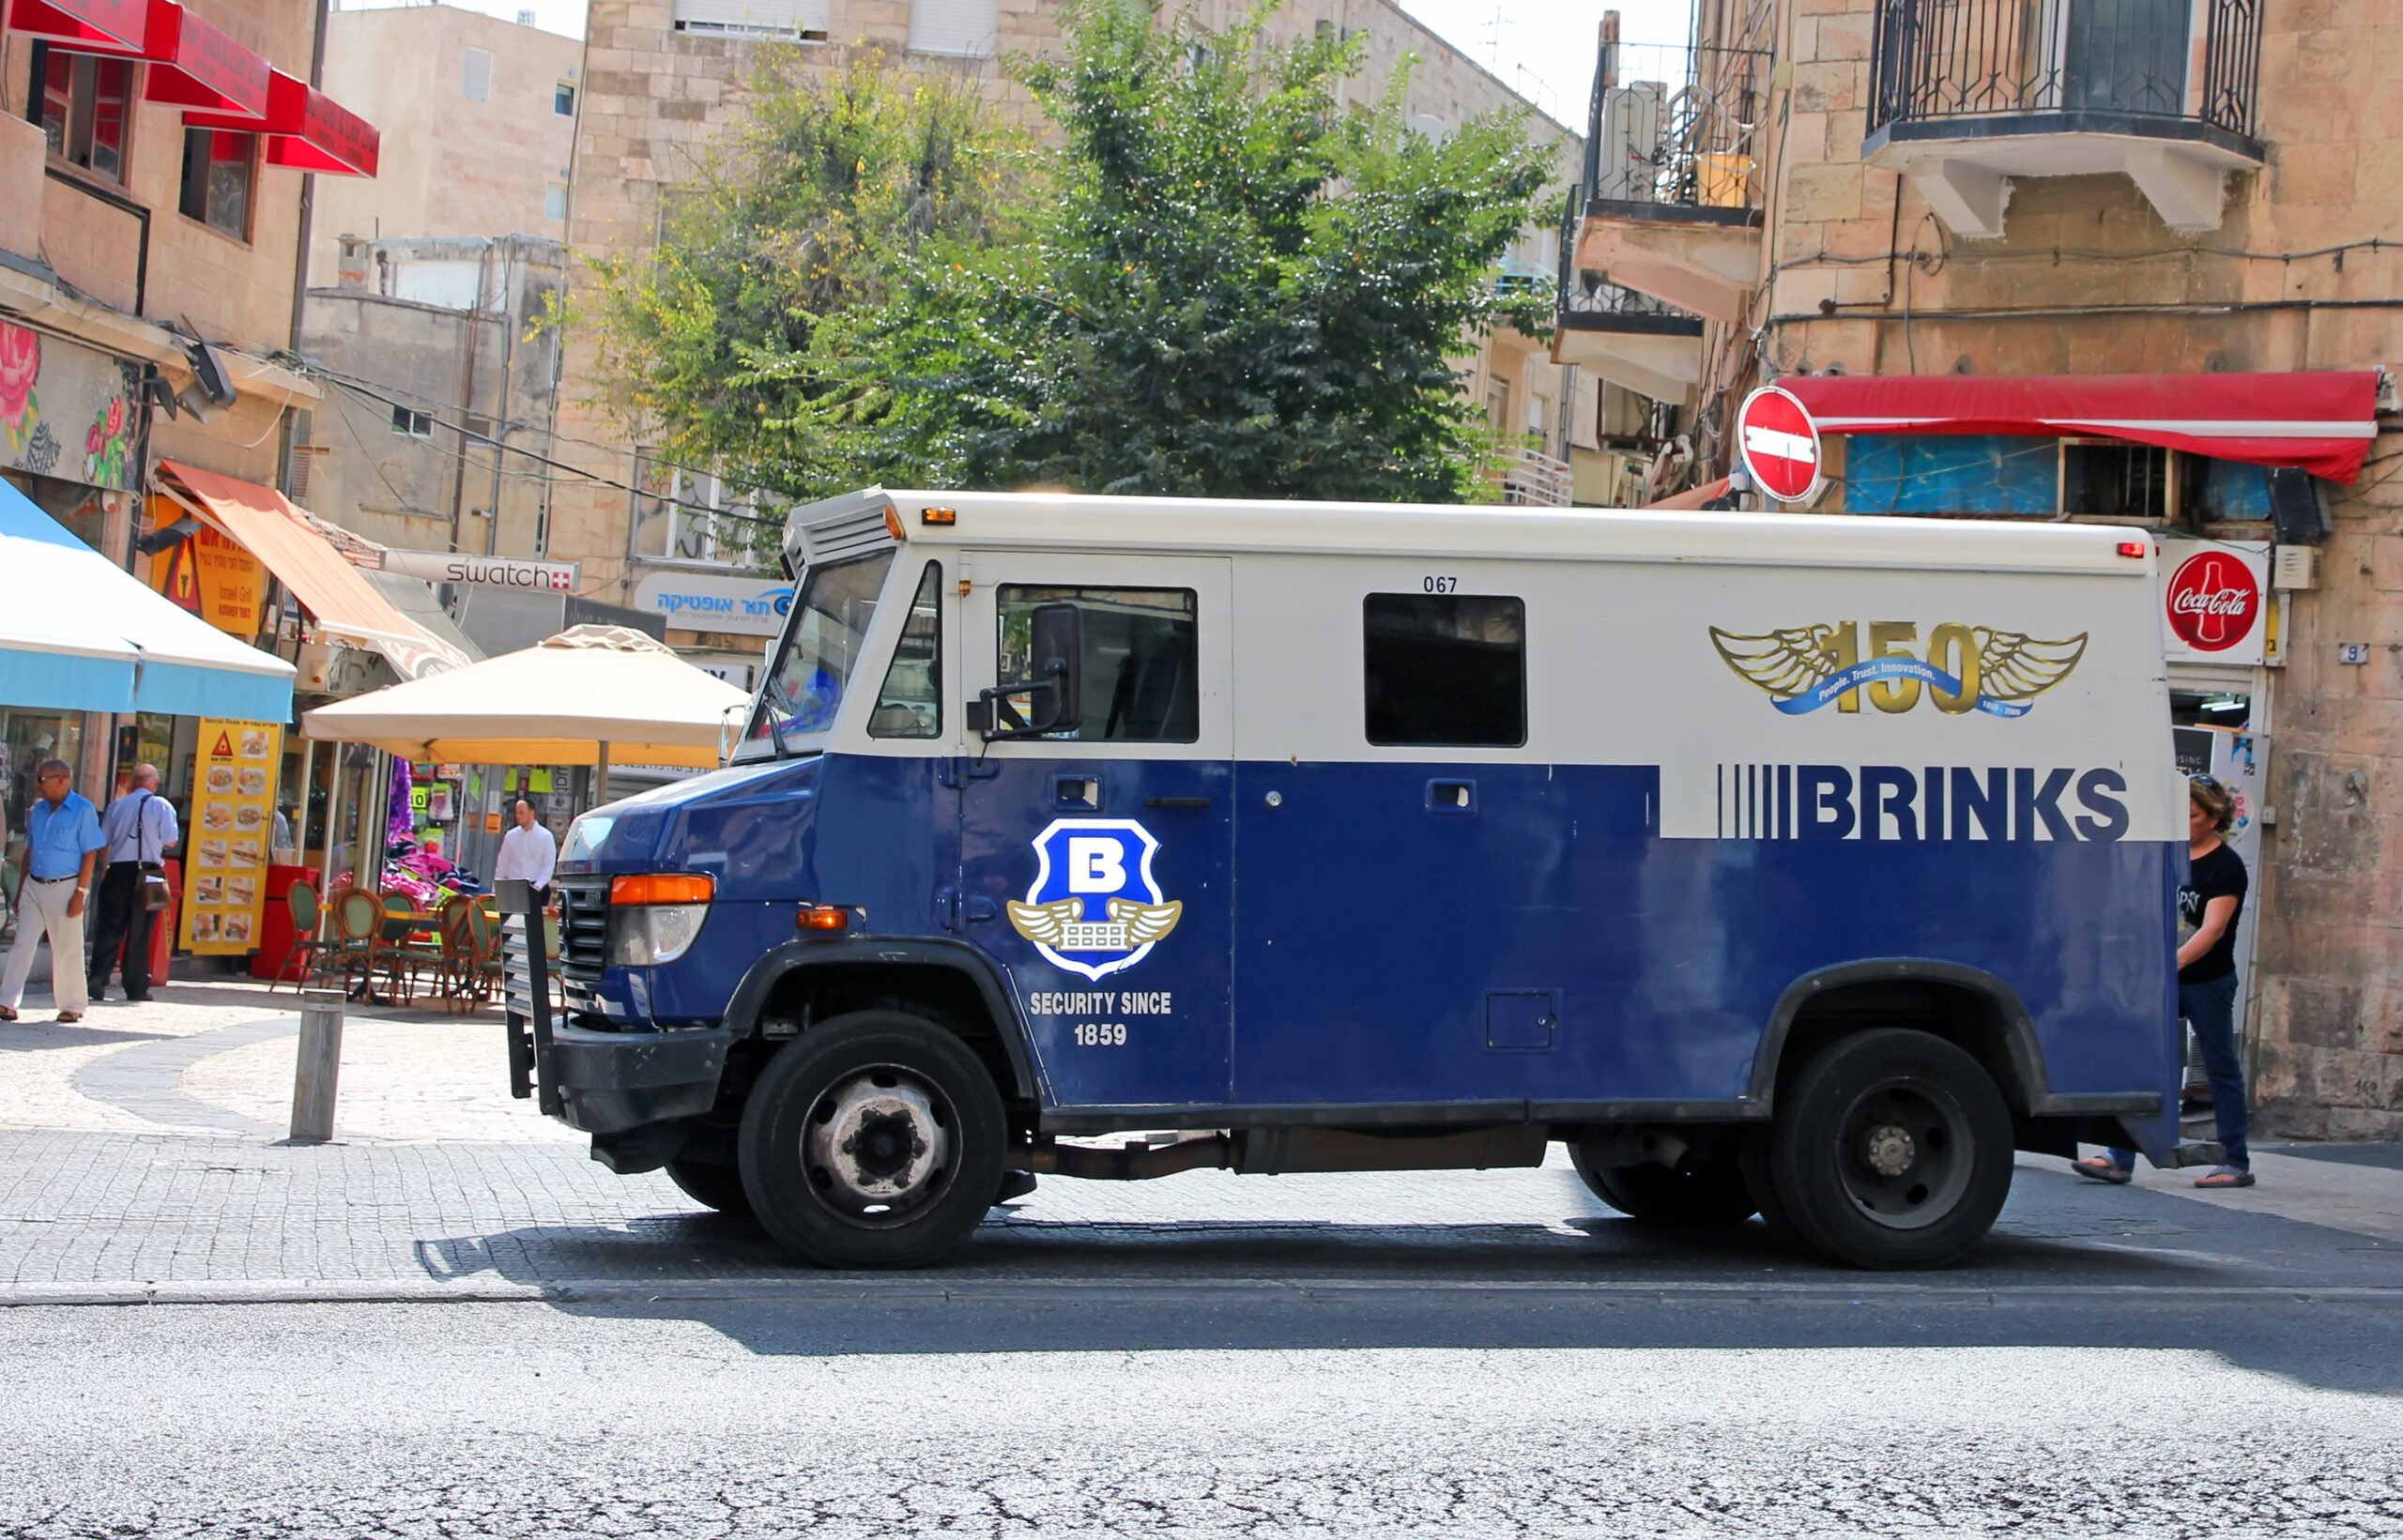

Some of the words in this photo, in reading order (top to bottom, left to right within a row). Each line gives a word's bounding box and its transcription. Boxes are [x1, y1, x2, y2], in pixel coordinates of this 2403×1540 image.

[447, 563, 550, 587] swatch
[1424, 576, 1457, 593] 067
[658, 593, 735, 613] אופטיקה
[2174, 587, 2251, 616] Coca-Cola
[1818, 676, 1851, 701] People.
[1851, 665, 1879, 681] Trust.
[1881, 658, 1936, 680] Innovation.
[1819, 620, 1981, 714] 150
[1797, 764, 2129, 843] BRINKS
[1068, 837, 1126, 893] B
[1031, 992, 1116, 1014] SECURITY
[1121, 992, 1171, 1014] SINCE
[1074, 1023, 1127, 1045] 1859
